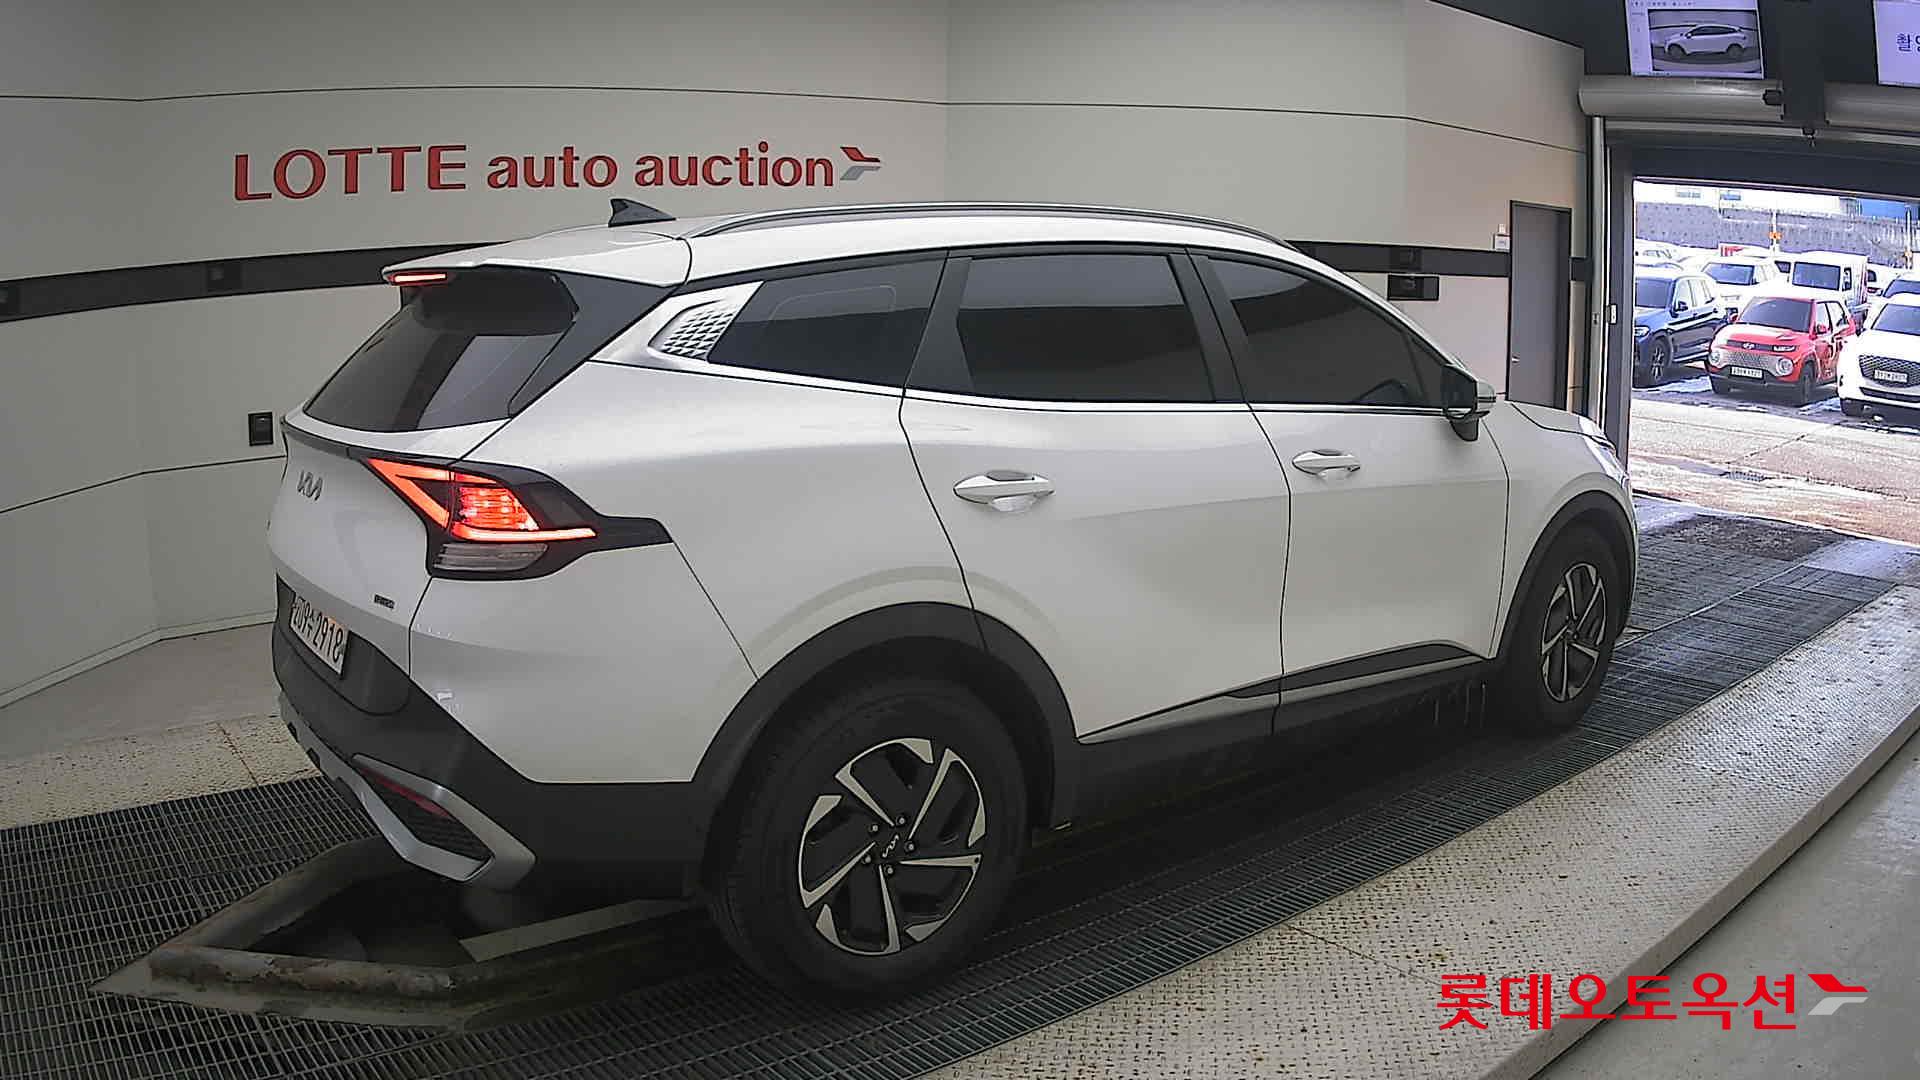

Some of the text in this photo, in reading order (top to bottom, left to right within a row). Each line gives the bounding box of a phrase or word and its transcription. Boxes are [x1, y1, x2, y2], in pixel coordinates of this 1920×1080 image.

[234, 141, 834, 201] LOTTE auto auction
